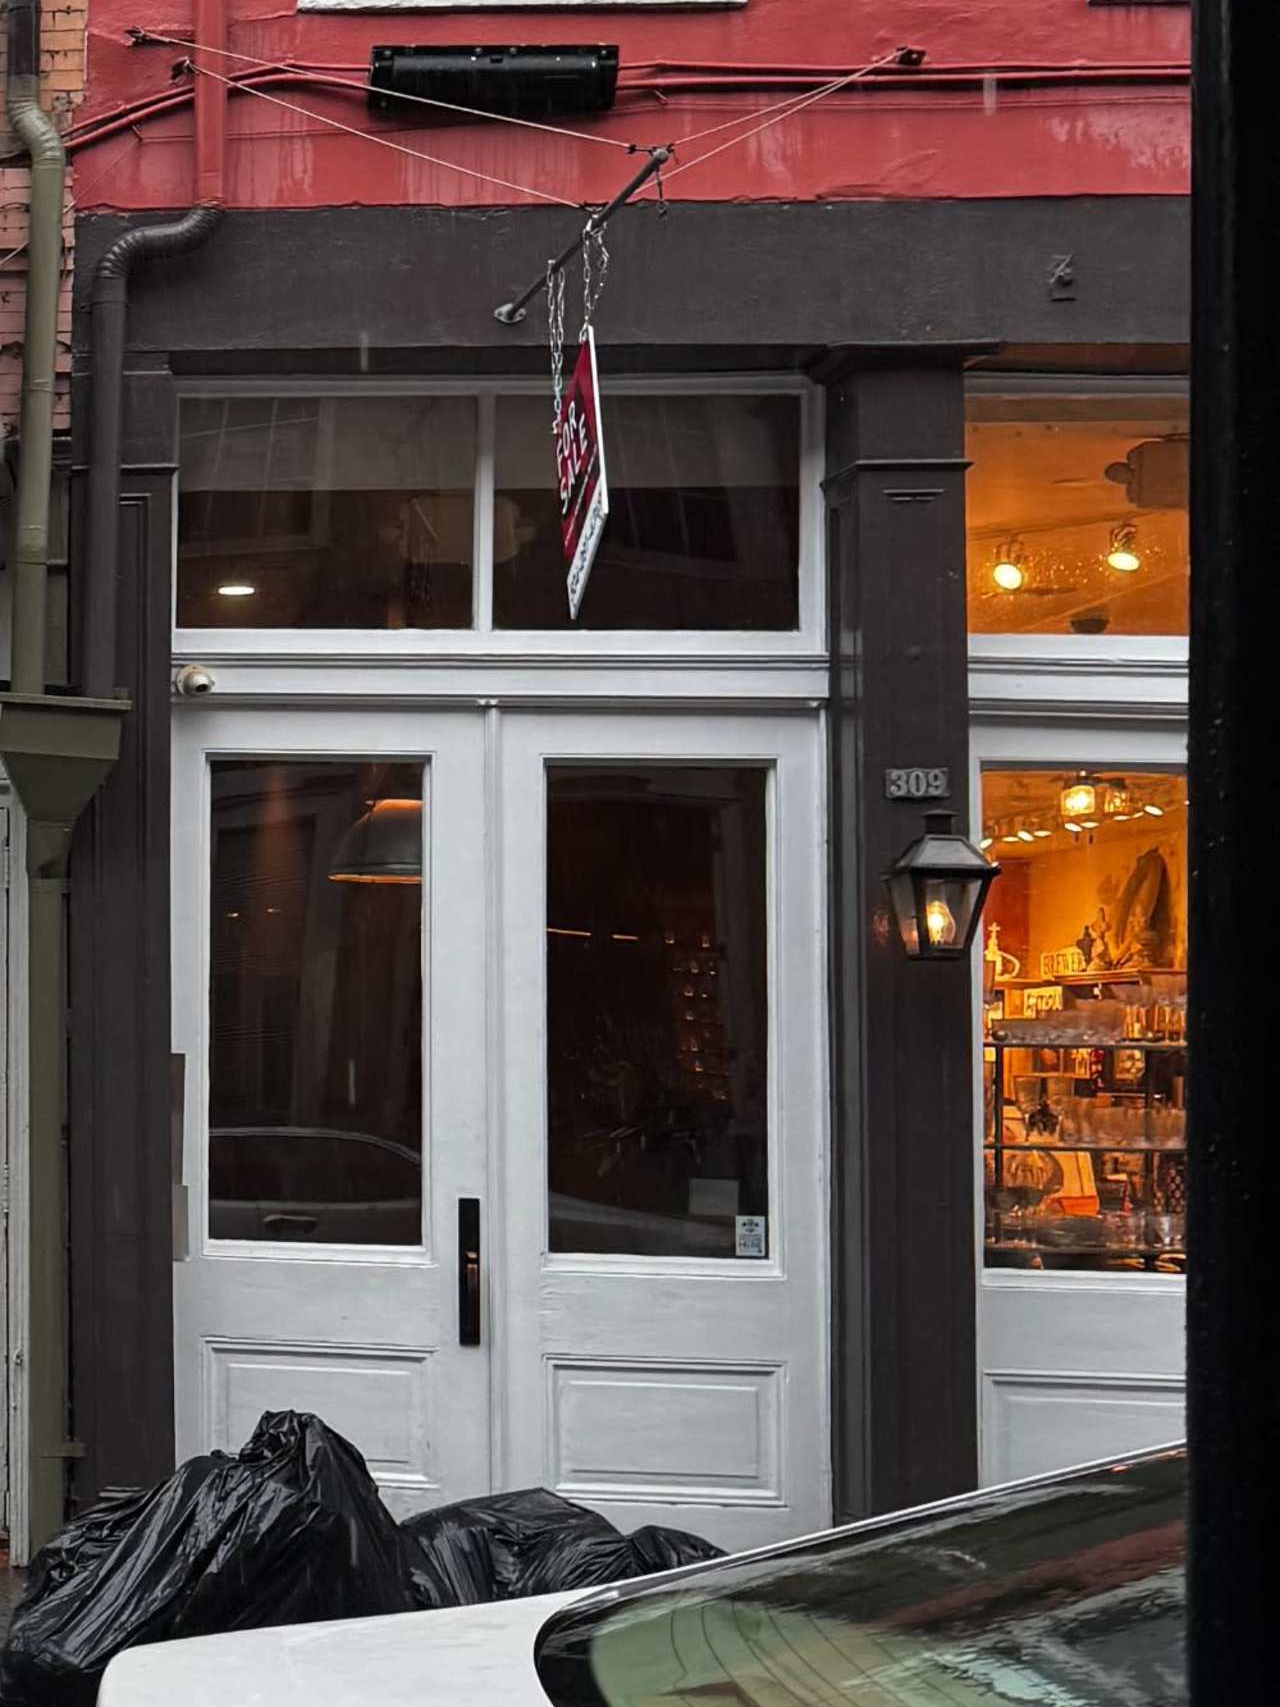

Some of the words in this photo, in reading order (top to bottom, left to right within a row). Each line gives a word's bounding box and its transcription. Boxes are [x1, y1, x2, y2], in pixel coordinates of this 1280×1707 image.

[556, 400, 577, 479] FOR
[560, 413, 588, 516] SALE
[890, 769, 946, 795] 309
